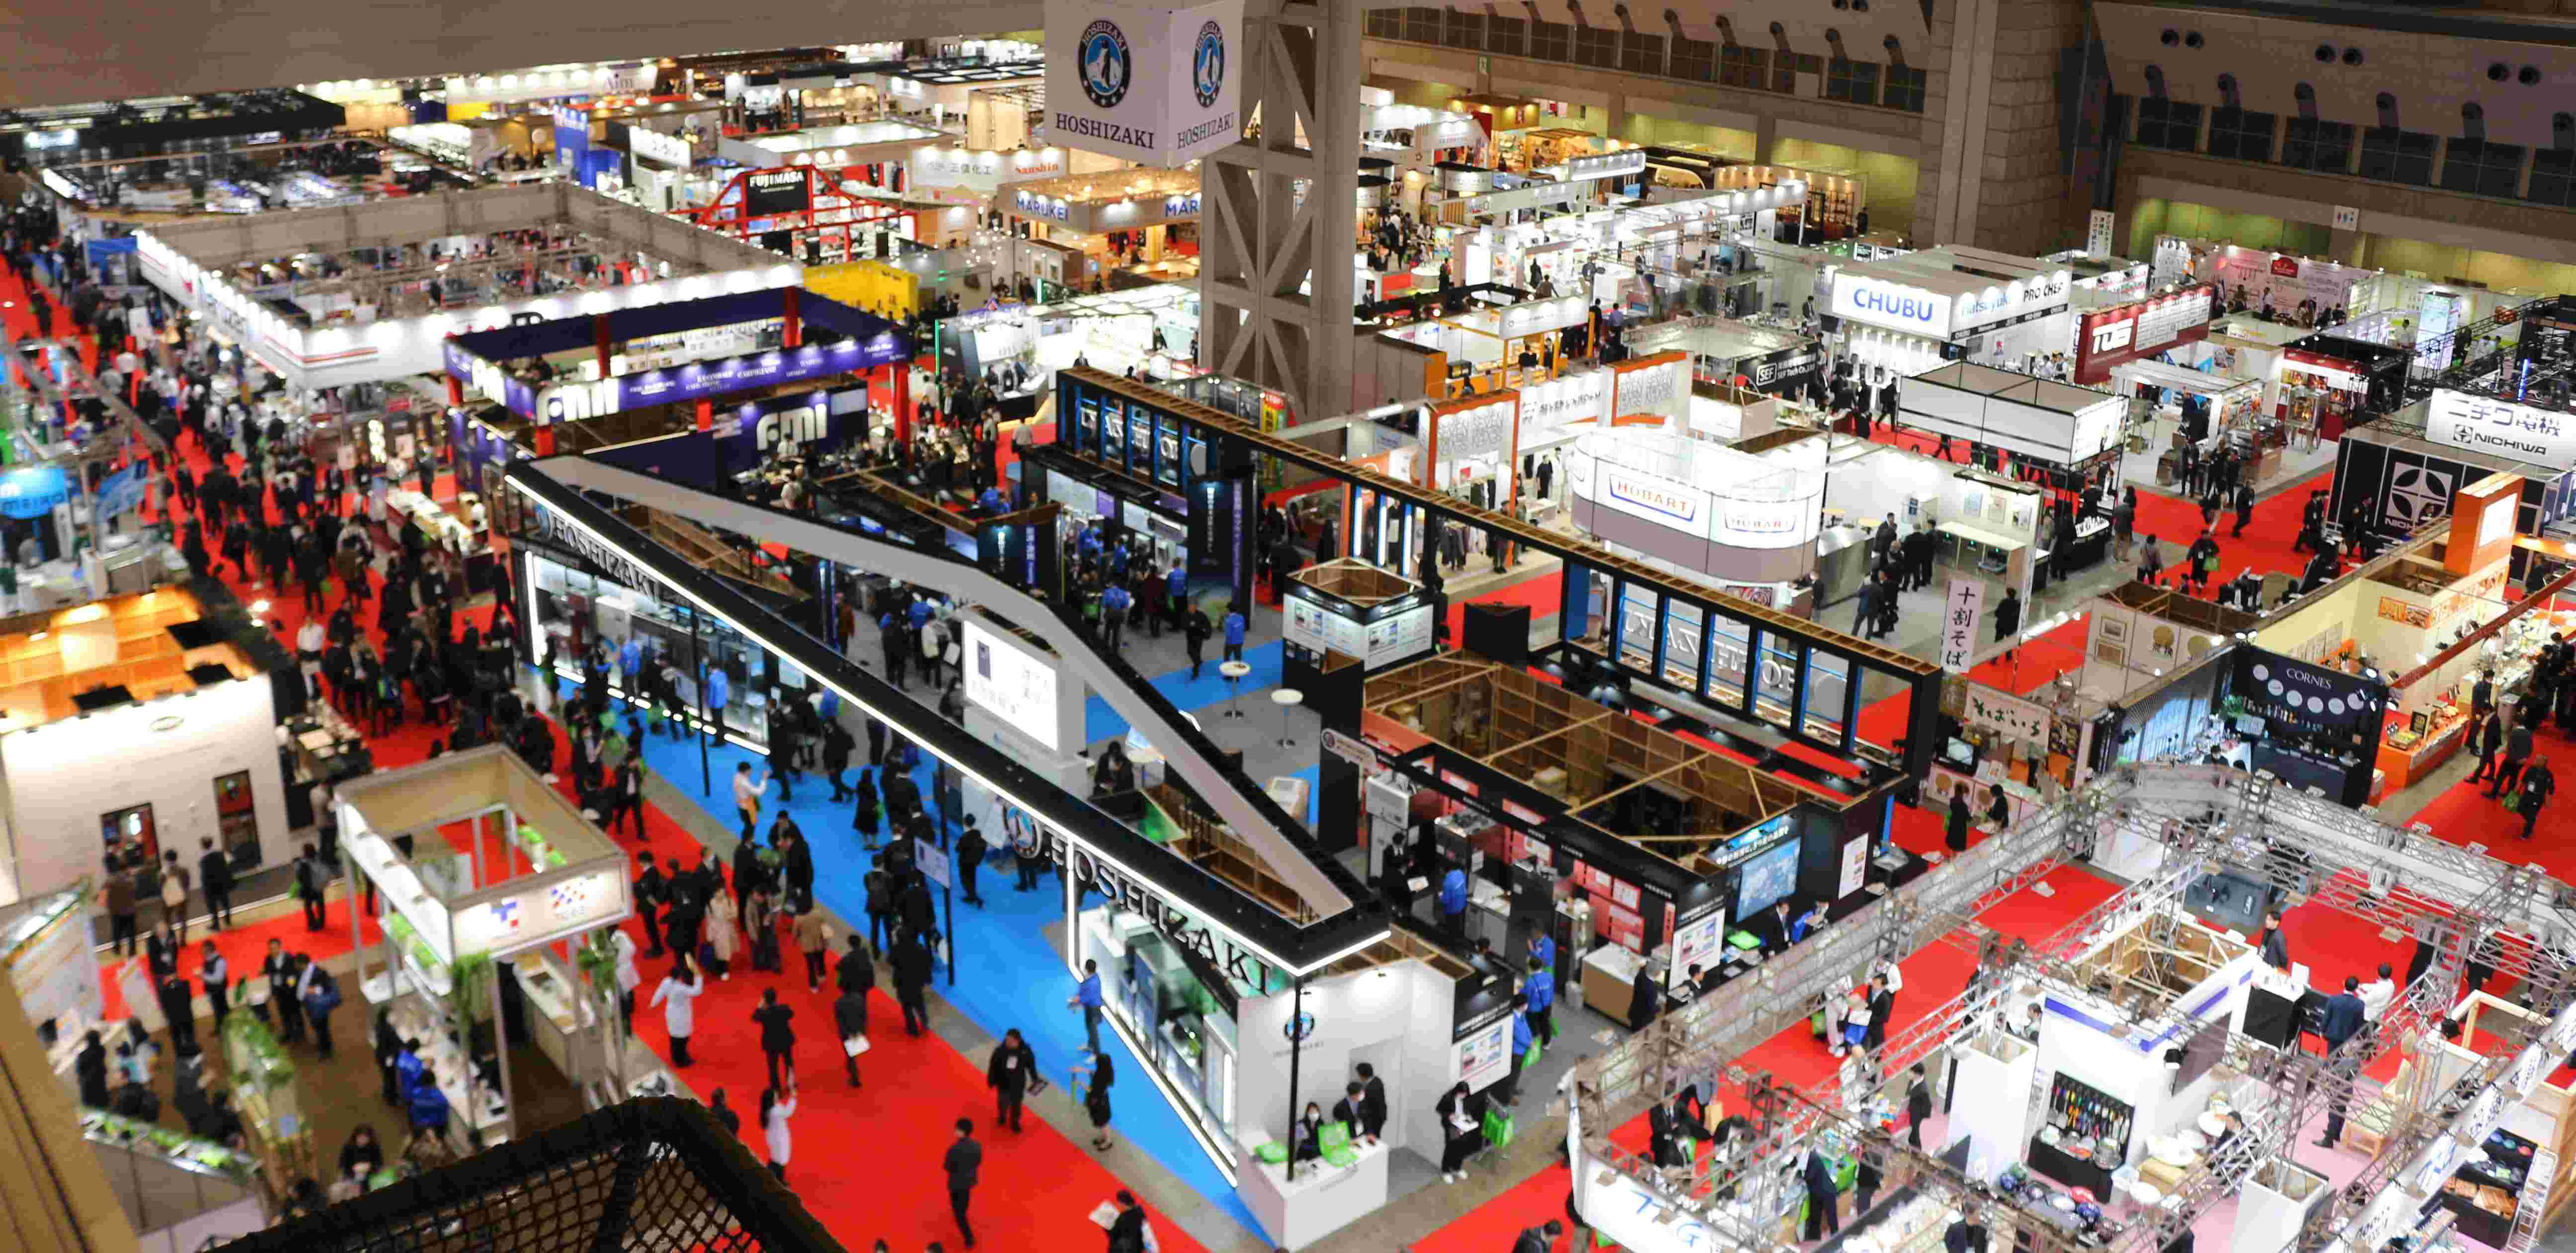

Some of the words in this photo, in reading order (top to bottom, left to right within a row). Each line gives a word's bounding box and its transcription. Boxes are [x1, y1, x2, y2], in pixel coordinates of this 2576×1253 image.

[1081, 21, 1127, 51] HOSHIZAKI
[1055, 112, 1154, 149] HOSHIZAKI
[1177, 112, 1234, 149] HOSHIZAKI
[749, 170, 805, 188] FUJIMASA
[1015, 163, 1058, 175] Sanshin
[1016, 198, 1069, 223] MARUKEI
[1852, 287, 1933, 322] CHUBU
[2023, 288, 2041, 302] PRO
[1759, 366, 1774, 382] SEF
[2474, 432, 2547, 455] NICHIWA
[1617, 479, 1687, 512] HOBART
[1945, 586, 1976, 668] 十割そば
[2286, 668, 2332, 689] CORNES
